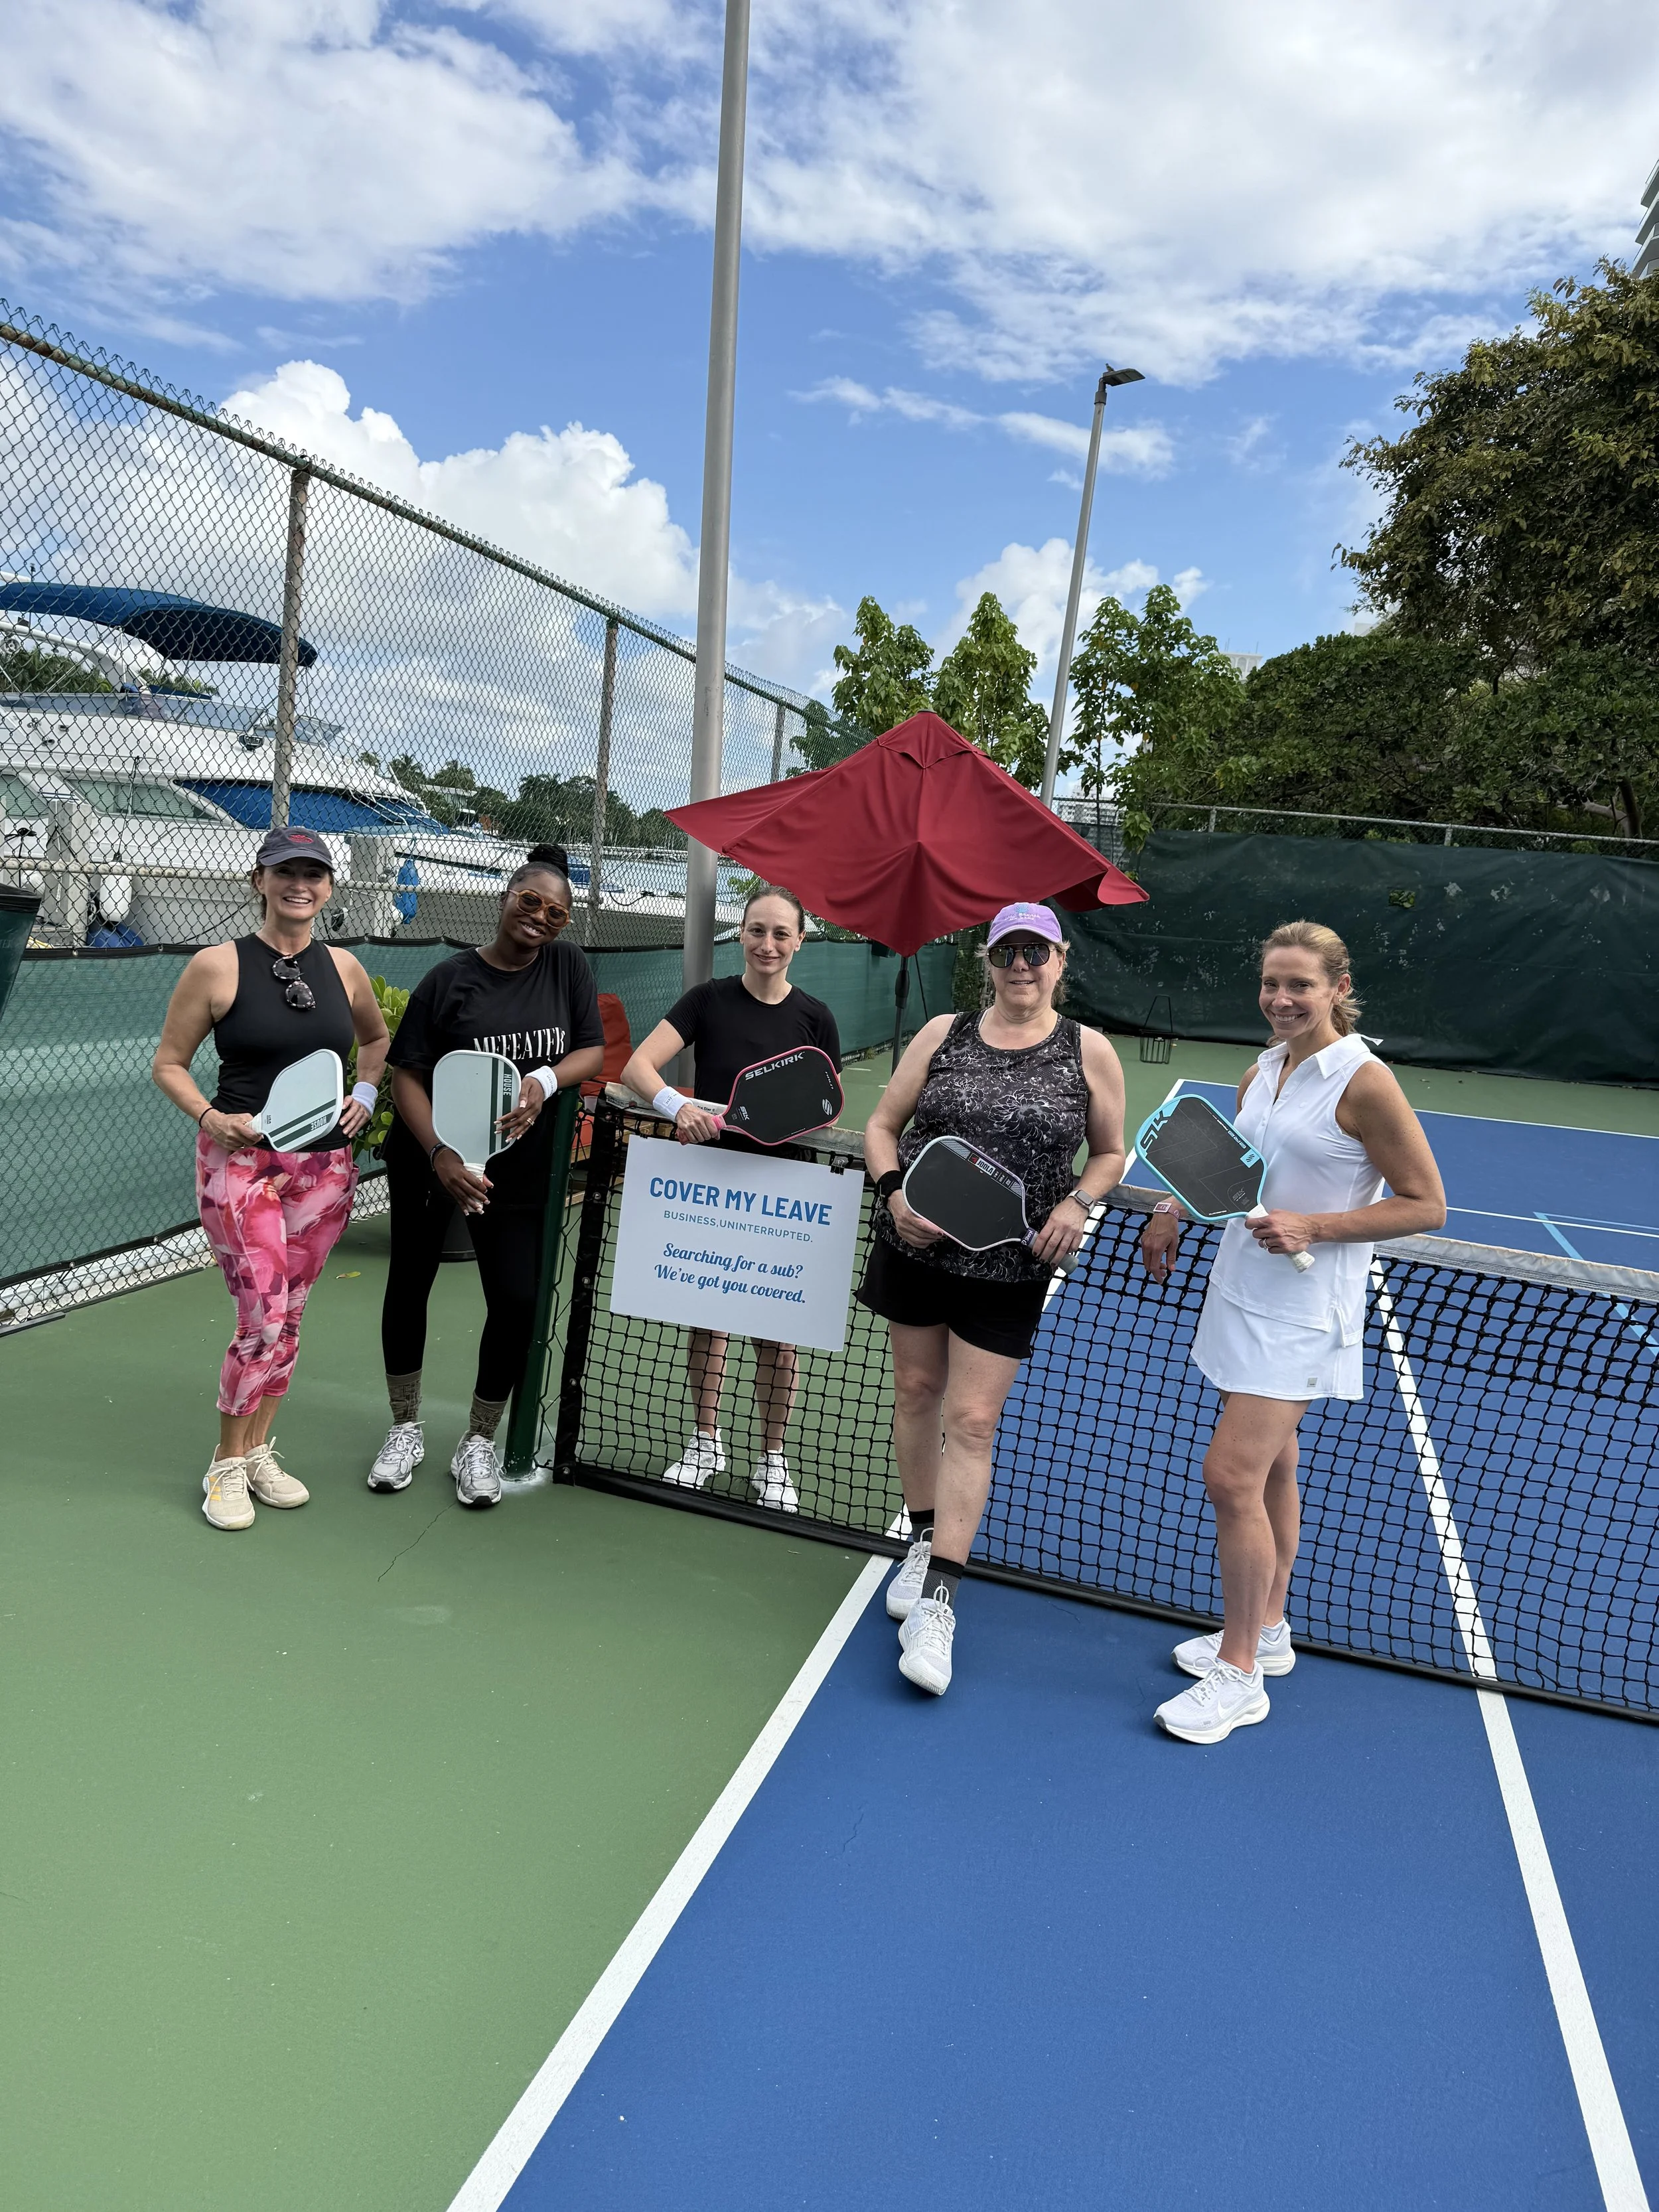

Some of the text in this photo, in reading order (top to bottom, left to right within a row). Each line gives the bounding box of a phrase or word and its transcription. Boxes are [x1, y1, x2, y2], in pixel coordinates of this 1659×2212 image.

[745, 1053, 805, 1080] SELKIRK
[503, 1073, 512, 1096] HOUSE
[310, 1116, 327, 1131] HOUSE
[739, 1106, 751, 1120] SLK
[977, 1160, 994, 1174] JOOLA
[650, 1177, 833, 1225] COVER MY LEAVE
[663, 1242, 804, 1279] Searching for a sub?
[697, 1275, 720, 1290] got
[722, 1280, 749, 1294] you
[751, 1285, 806, 1303] covered.
